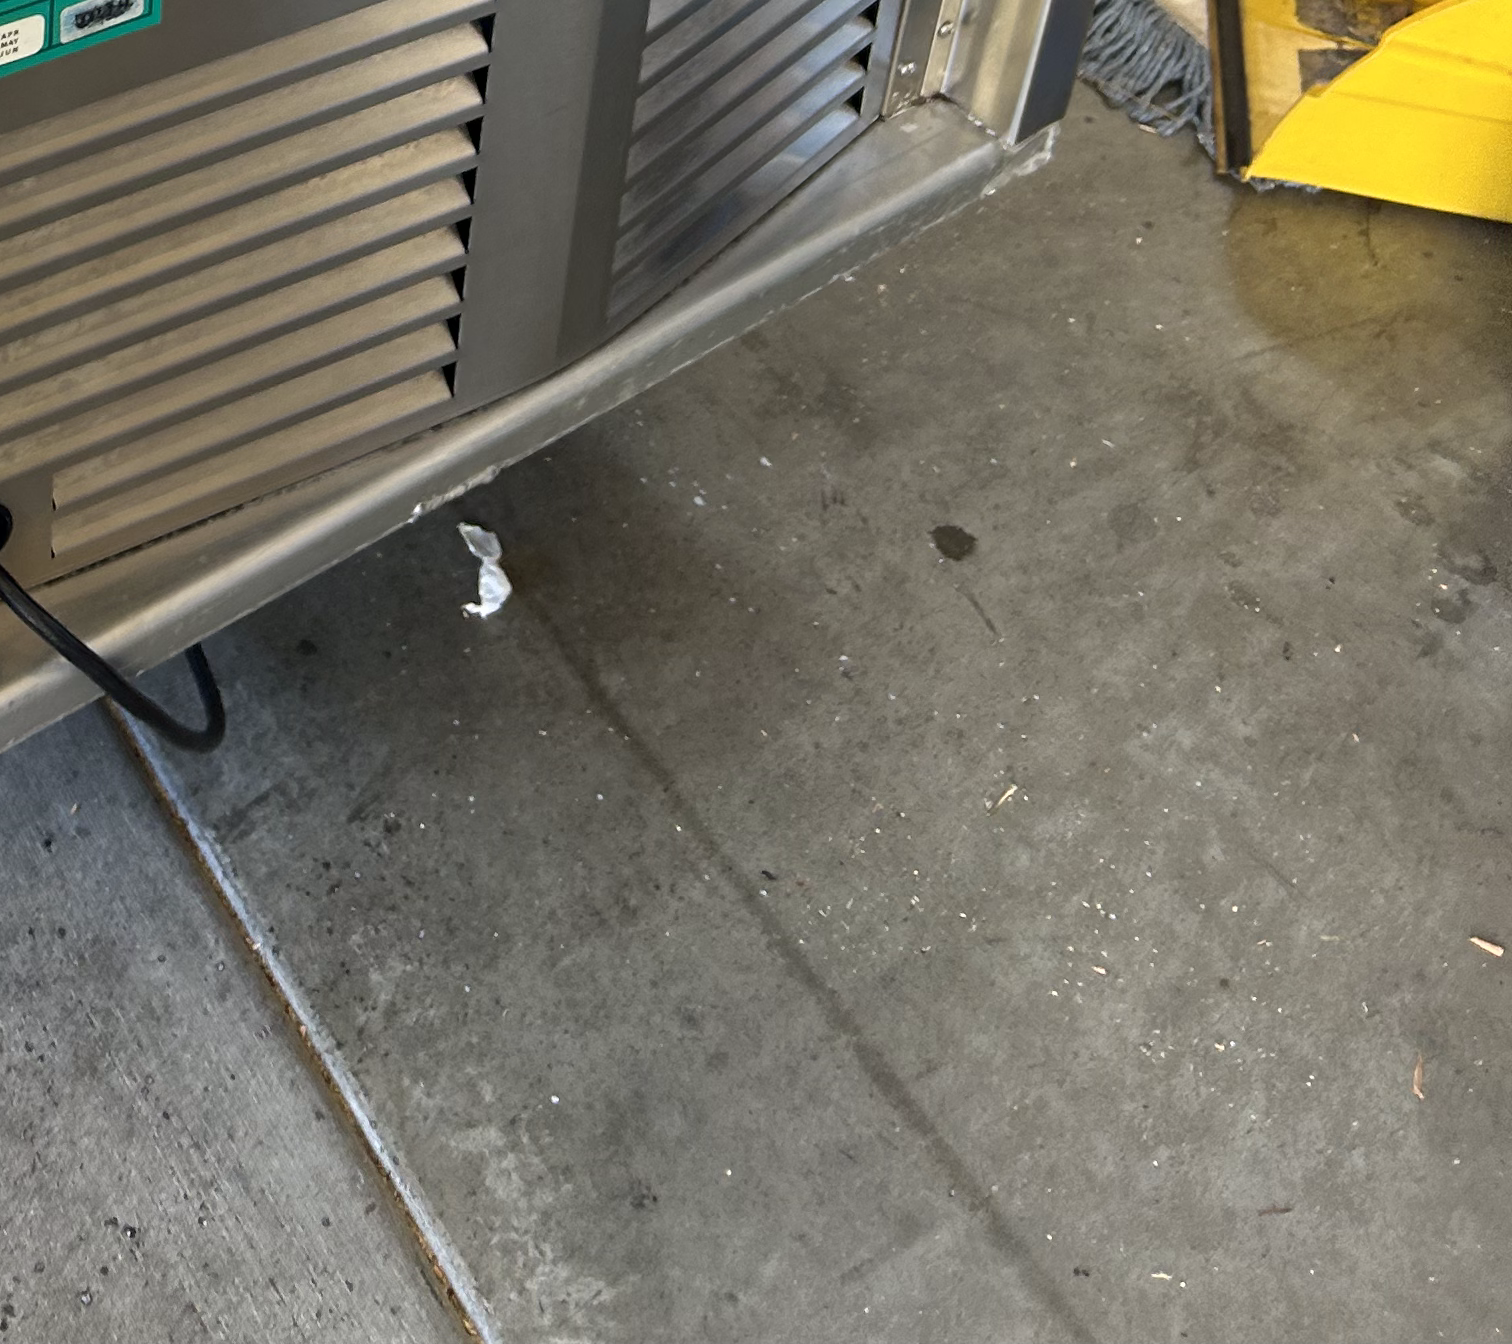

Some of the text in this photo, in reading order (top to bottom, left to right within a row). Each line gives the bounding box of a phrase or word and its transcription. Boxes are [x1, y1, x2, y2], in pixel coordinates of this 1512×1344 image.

[1, 29, 20, 41] APR
[0, 38, 19, 49] MAY
[0, 47, 19, 58] JUN
